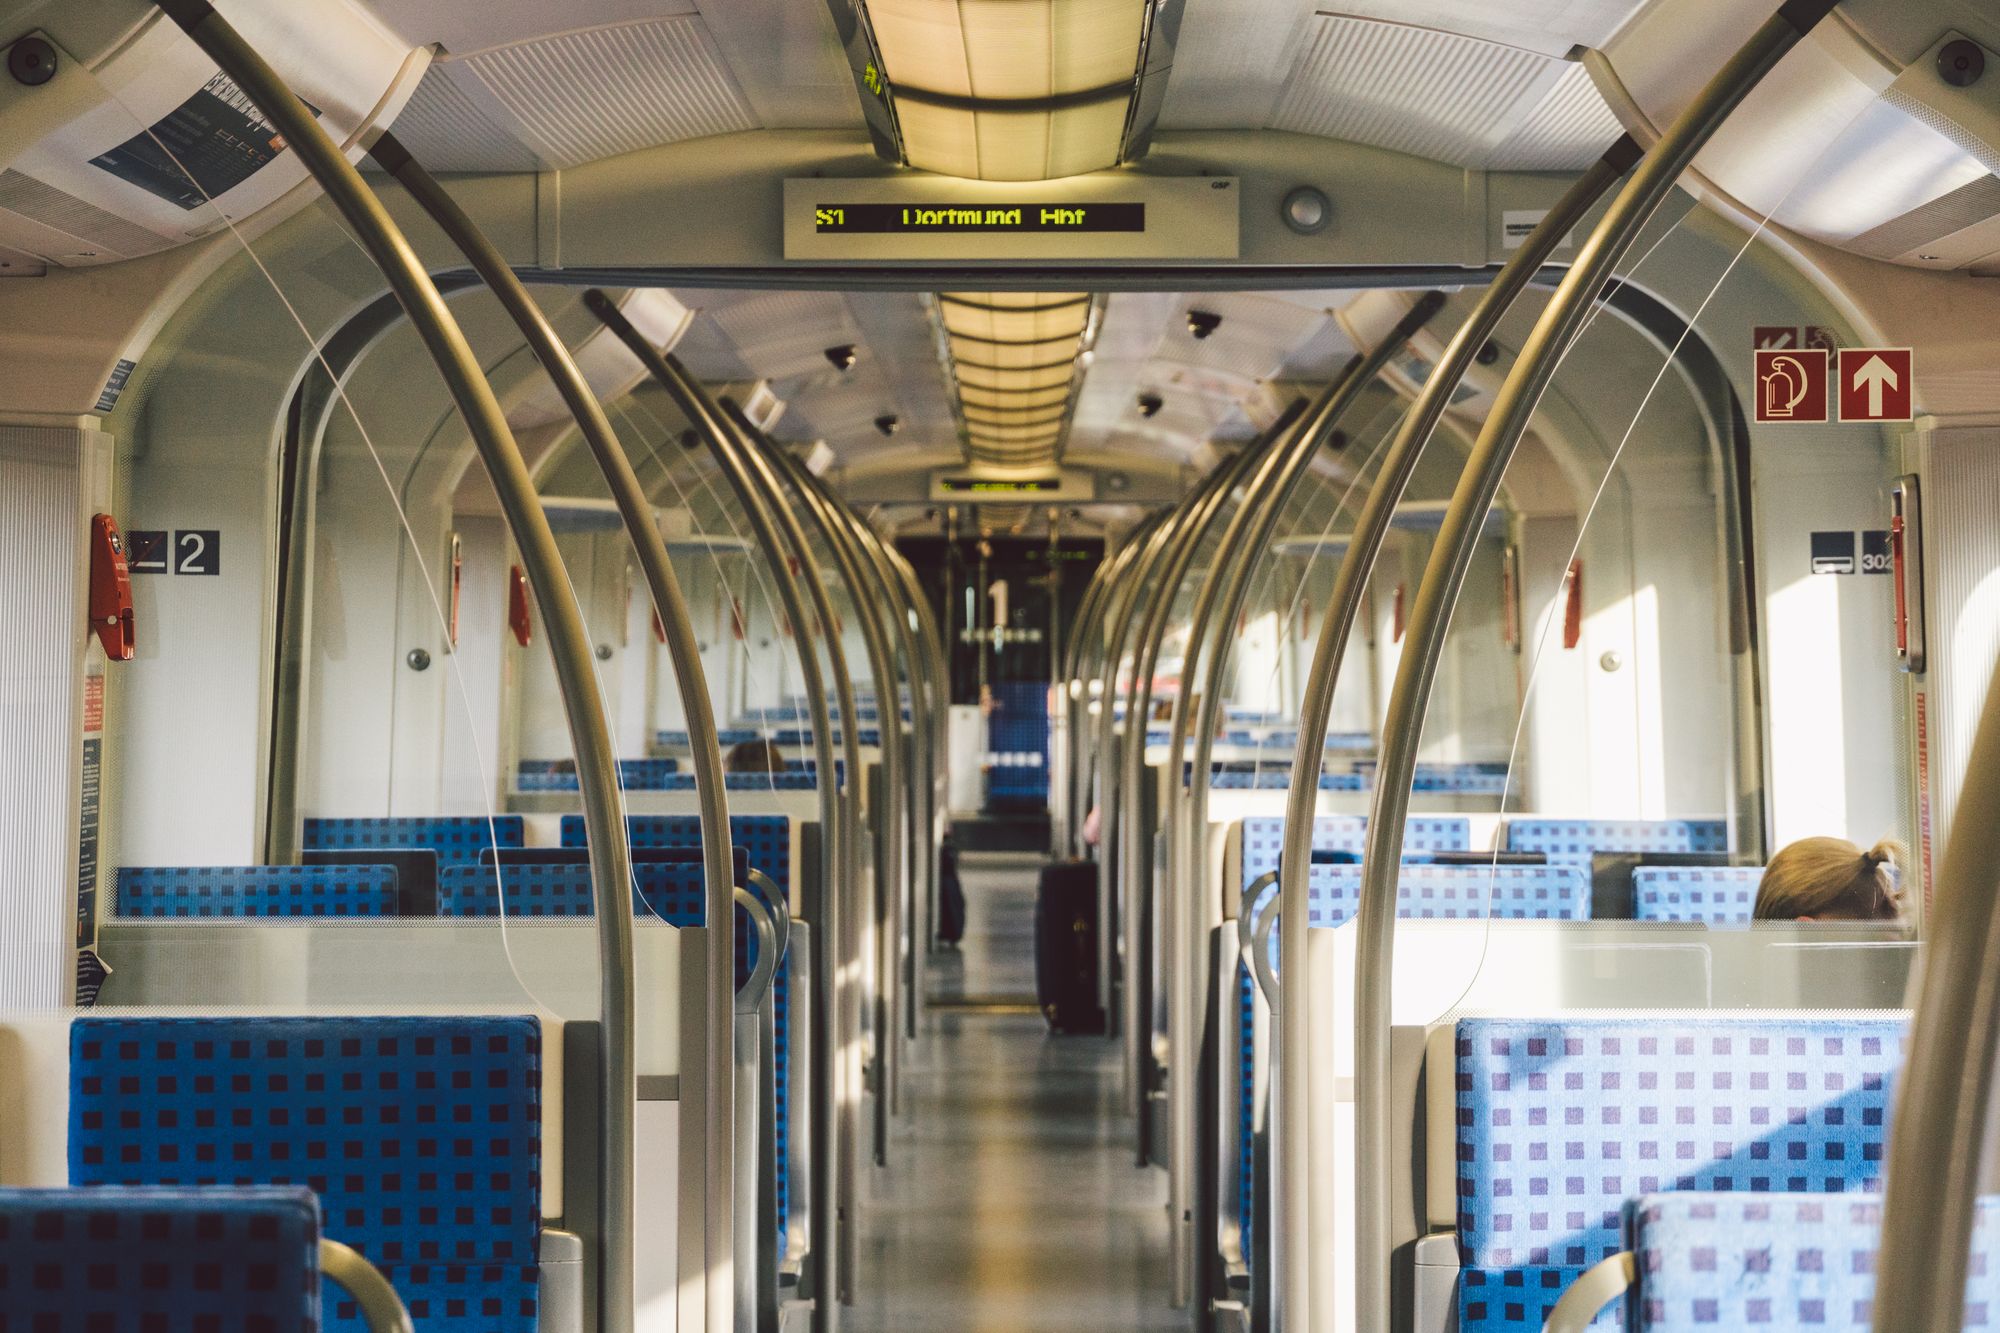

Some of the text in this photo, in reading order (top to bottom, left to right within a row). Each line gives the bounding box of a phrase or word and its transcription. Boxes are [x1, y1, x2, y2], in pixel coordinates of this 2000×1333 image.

[815, 208, 1086, 225] S1 Dortmund Hbf
[180, 533, 205, 572] 2
